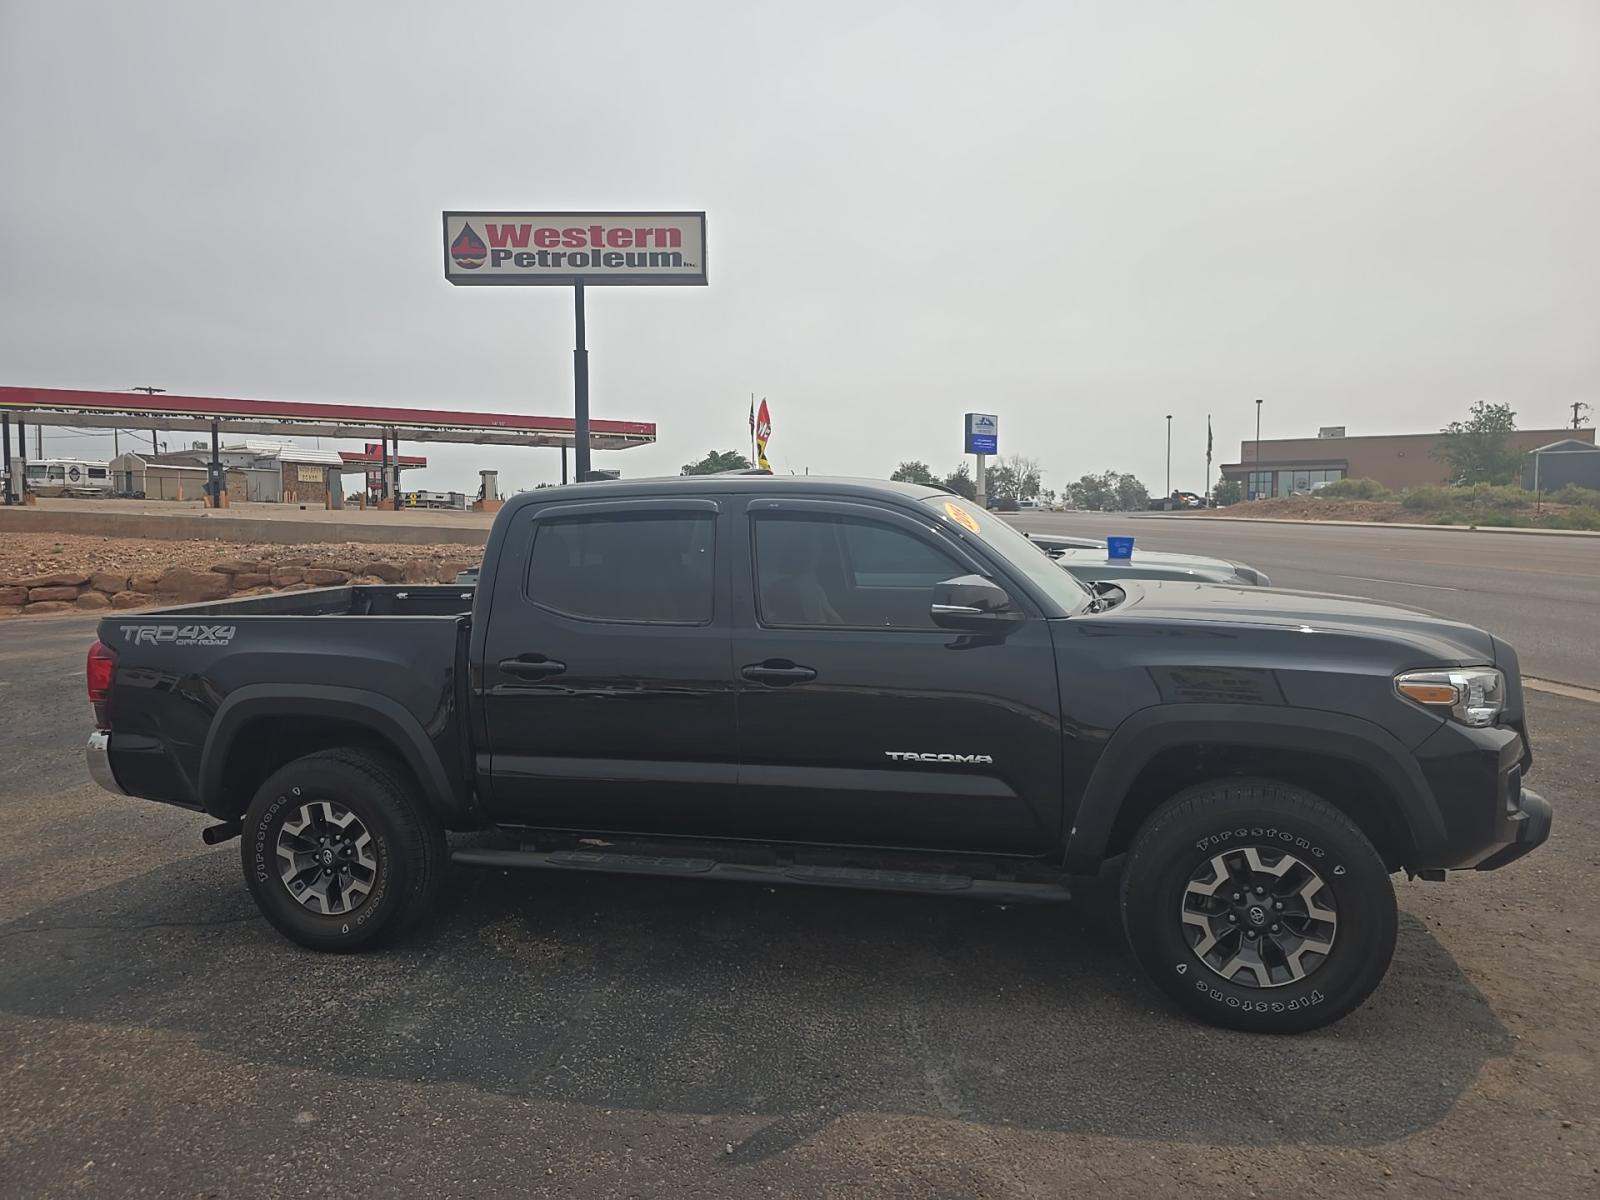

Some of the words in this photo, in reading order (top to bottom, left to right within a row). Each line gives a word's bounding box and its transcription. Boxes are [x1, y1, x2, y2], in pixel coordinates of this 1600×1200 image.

[486, 223, 682, 248] Western
[491, 249, 682, 268] Petroleum
[120, 625, 178, 645] TRD
[885, 751, 993, 764] TACOMA
